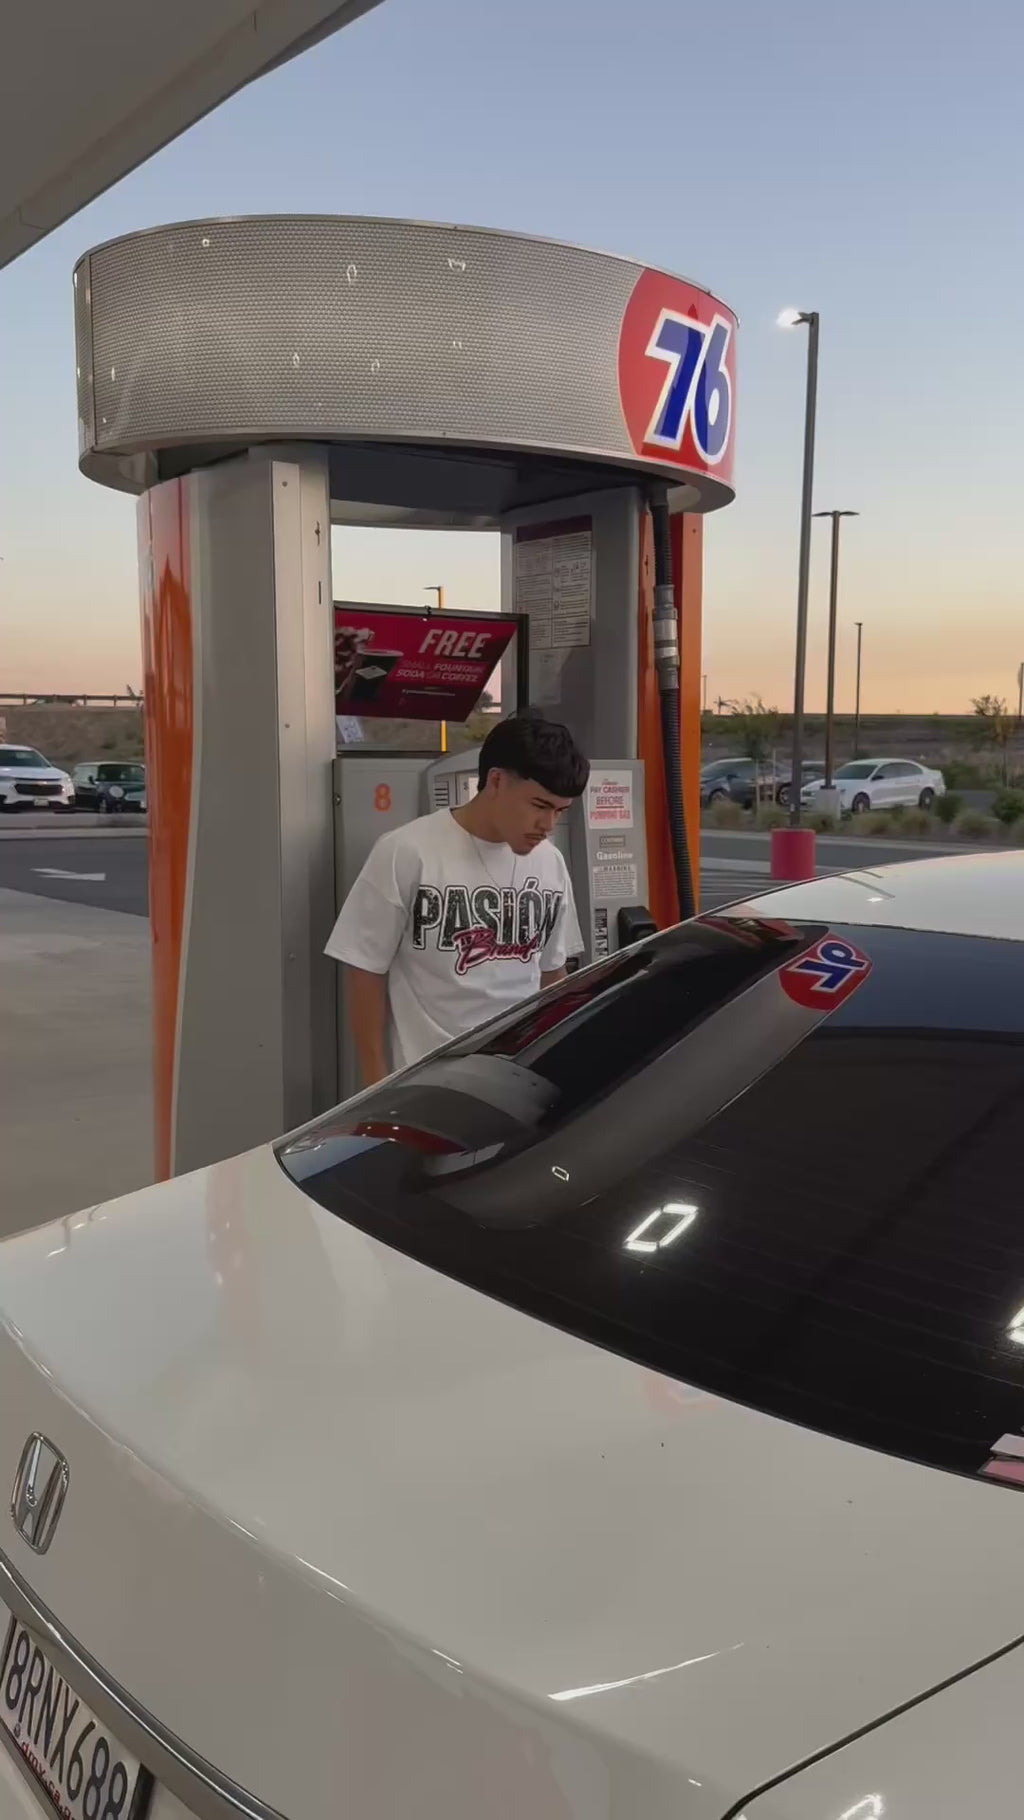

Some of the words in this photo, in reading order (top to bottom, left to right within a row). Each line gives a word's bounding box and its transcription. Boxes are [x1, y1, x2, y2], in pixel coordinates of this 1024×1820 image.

[644, 307, 732, 465] 76
[418, 628, 492, 658] FREE
[396, 669, 425, 679] SODA
[441, 671, 478, 682] COFFEE
[374, 782, 391, 813] 8
[596, 795, 624, 805] BEFORE
[602, 785, 630, 793] CASHIER
[596, 850, 633, 861] Gasoline
[452, 924, 539, 975] Brand
[5, 1630, 128, 1820] 8RNX688
[21, 1741, 75, 1820] dmv.ca.g
